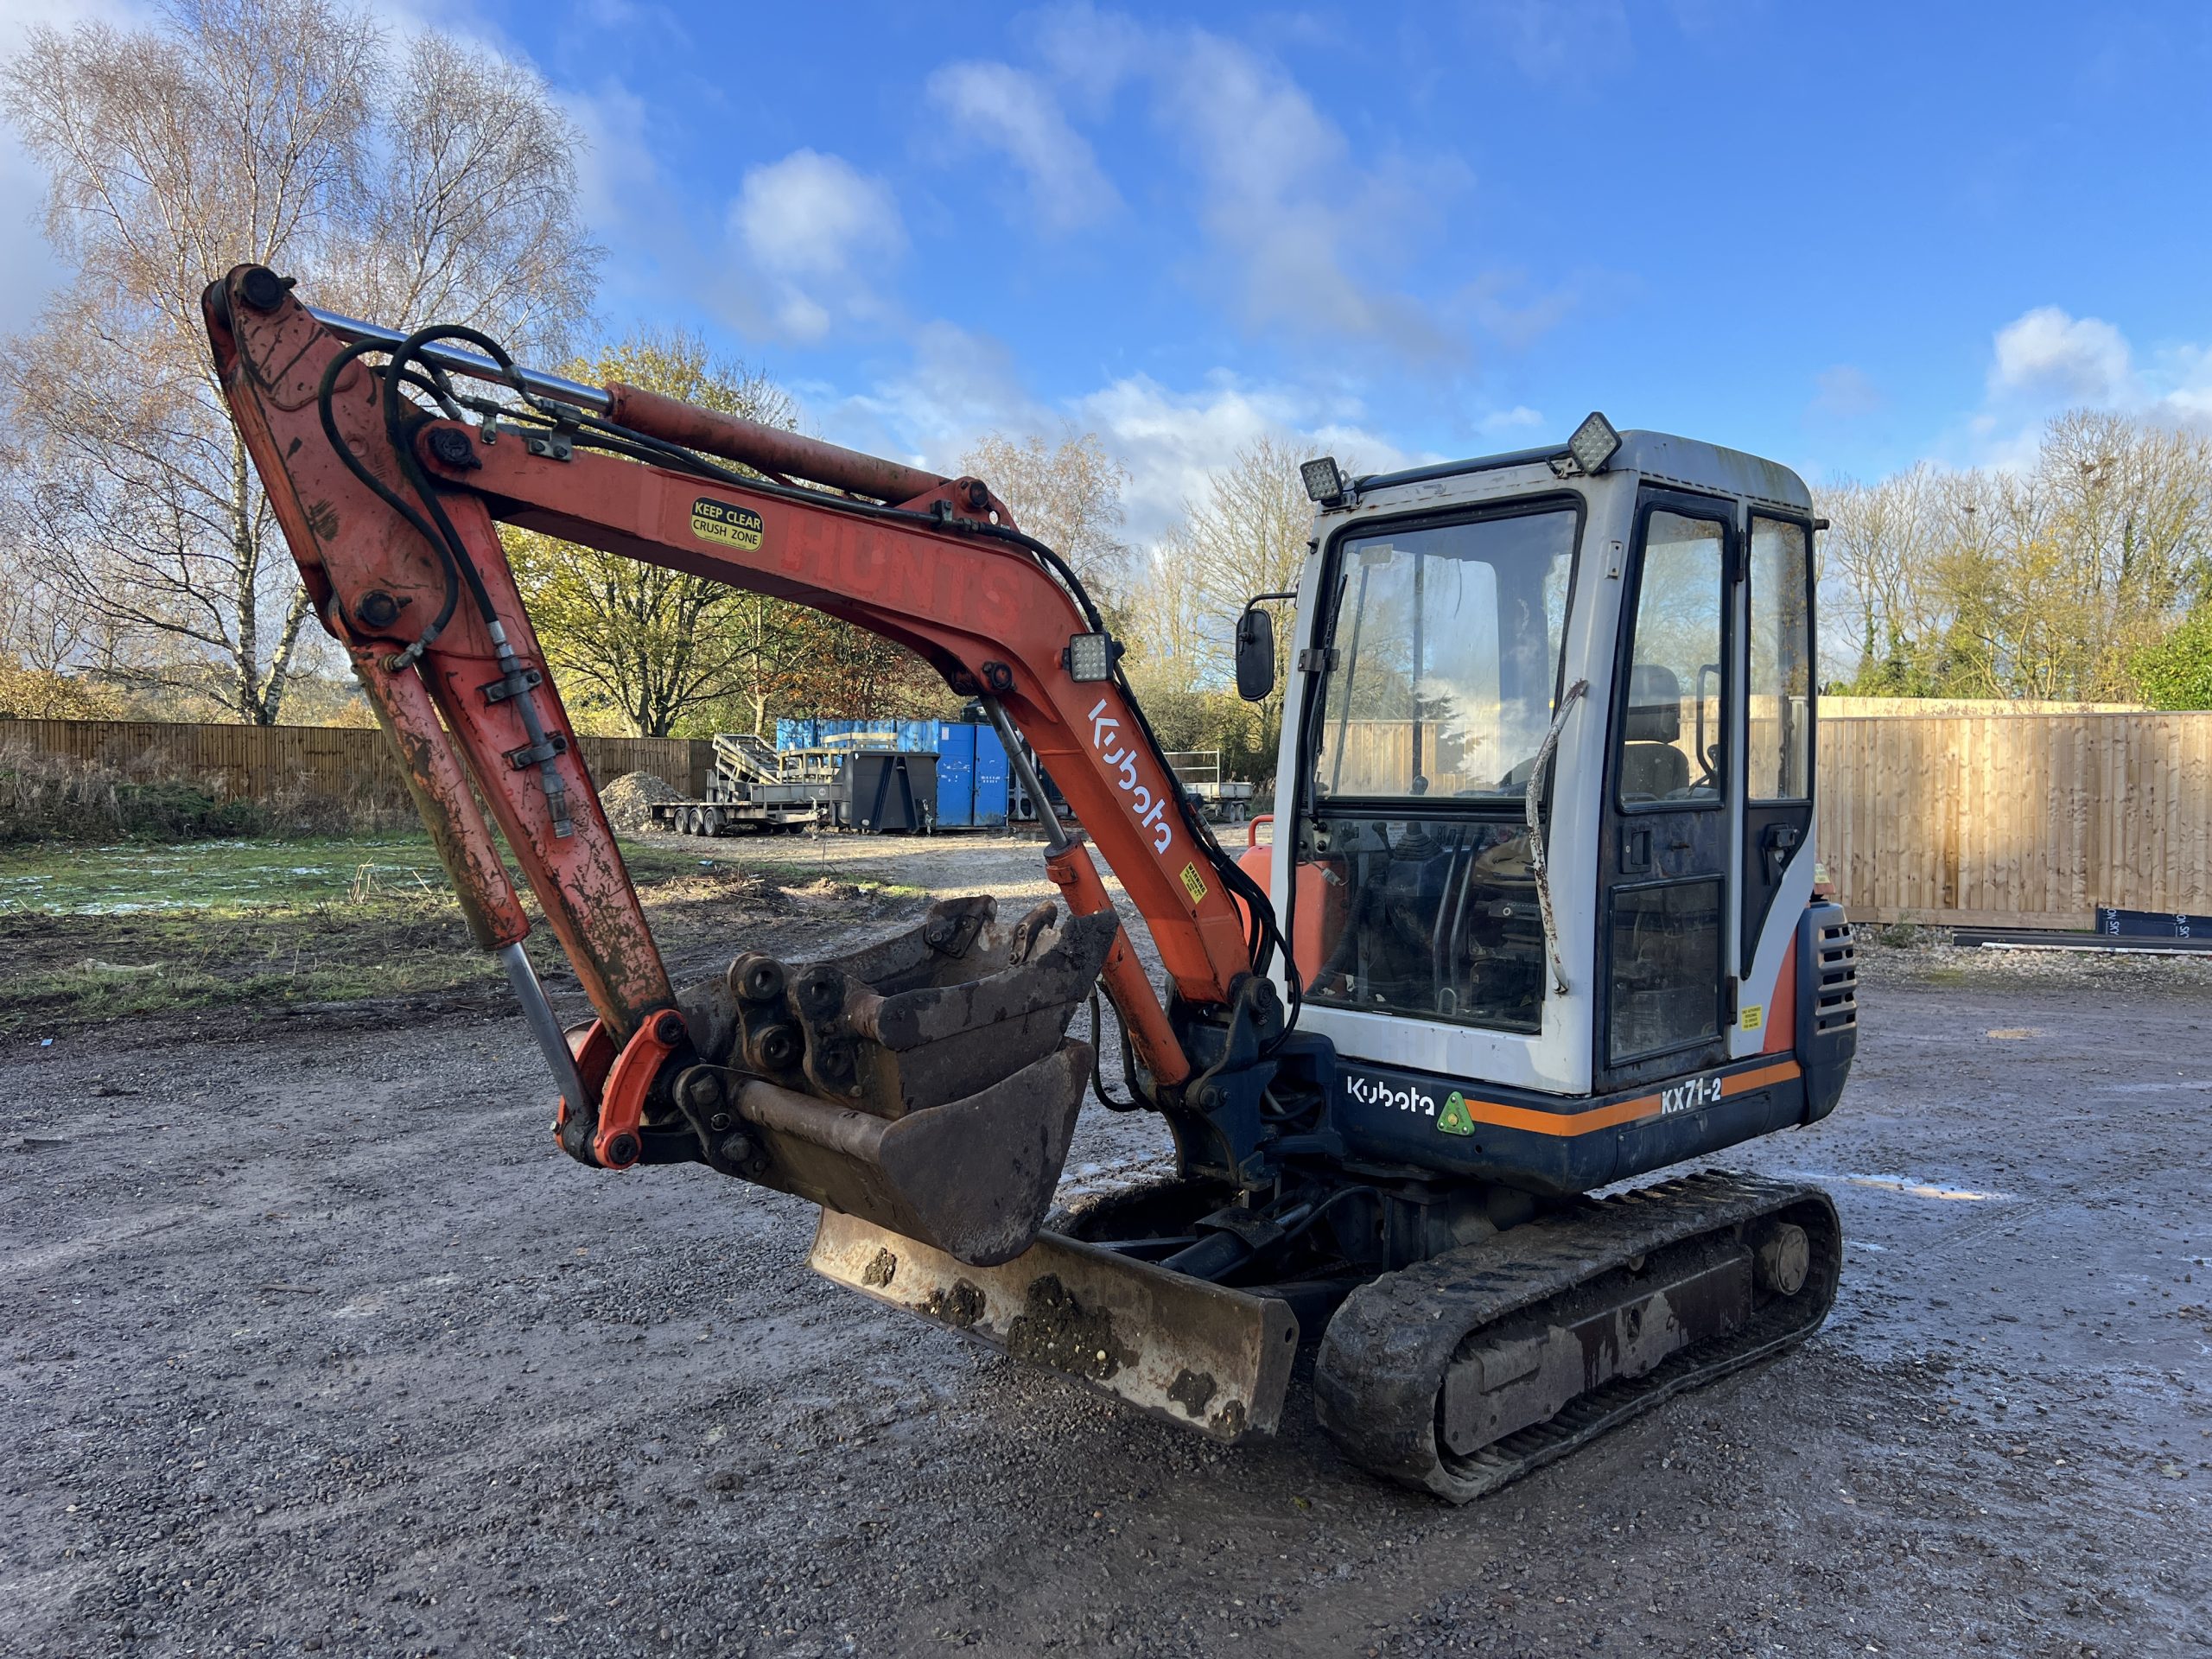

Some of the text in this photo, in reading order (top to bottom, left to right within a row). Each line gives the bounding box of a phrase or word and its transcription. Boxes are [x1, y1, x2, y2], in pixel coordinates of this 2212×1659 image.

[695, 502, 760, 530] KEEP CLEAR
[693, 519, 727, 537] CRUSH
[731, 529, 758, 545] ZONE
[1088, 698, 1172, 855] Kubota
[1188, 863, 1206, 893] WARNING
[2109, 920, 2120, 936] SKY
[1347, 1076, 1434, 1116] Kubota
[1662, 1077, 1722, 1116] KX71-2
